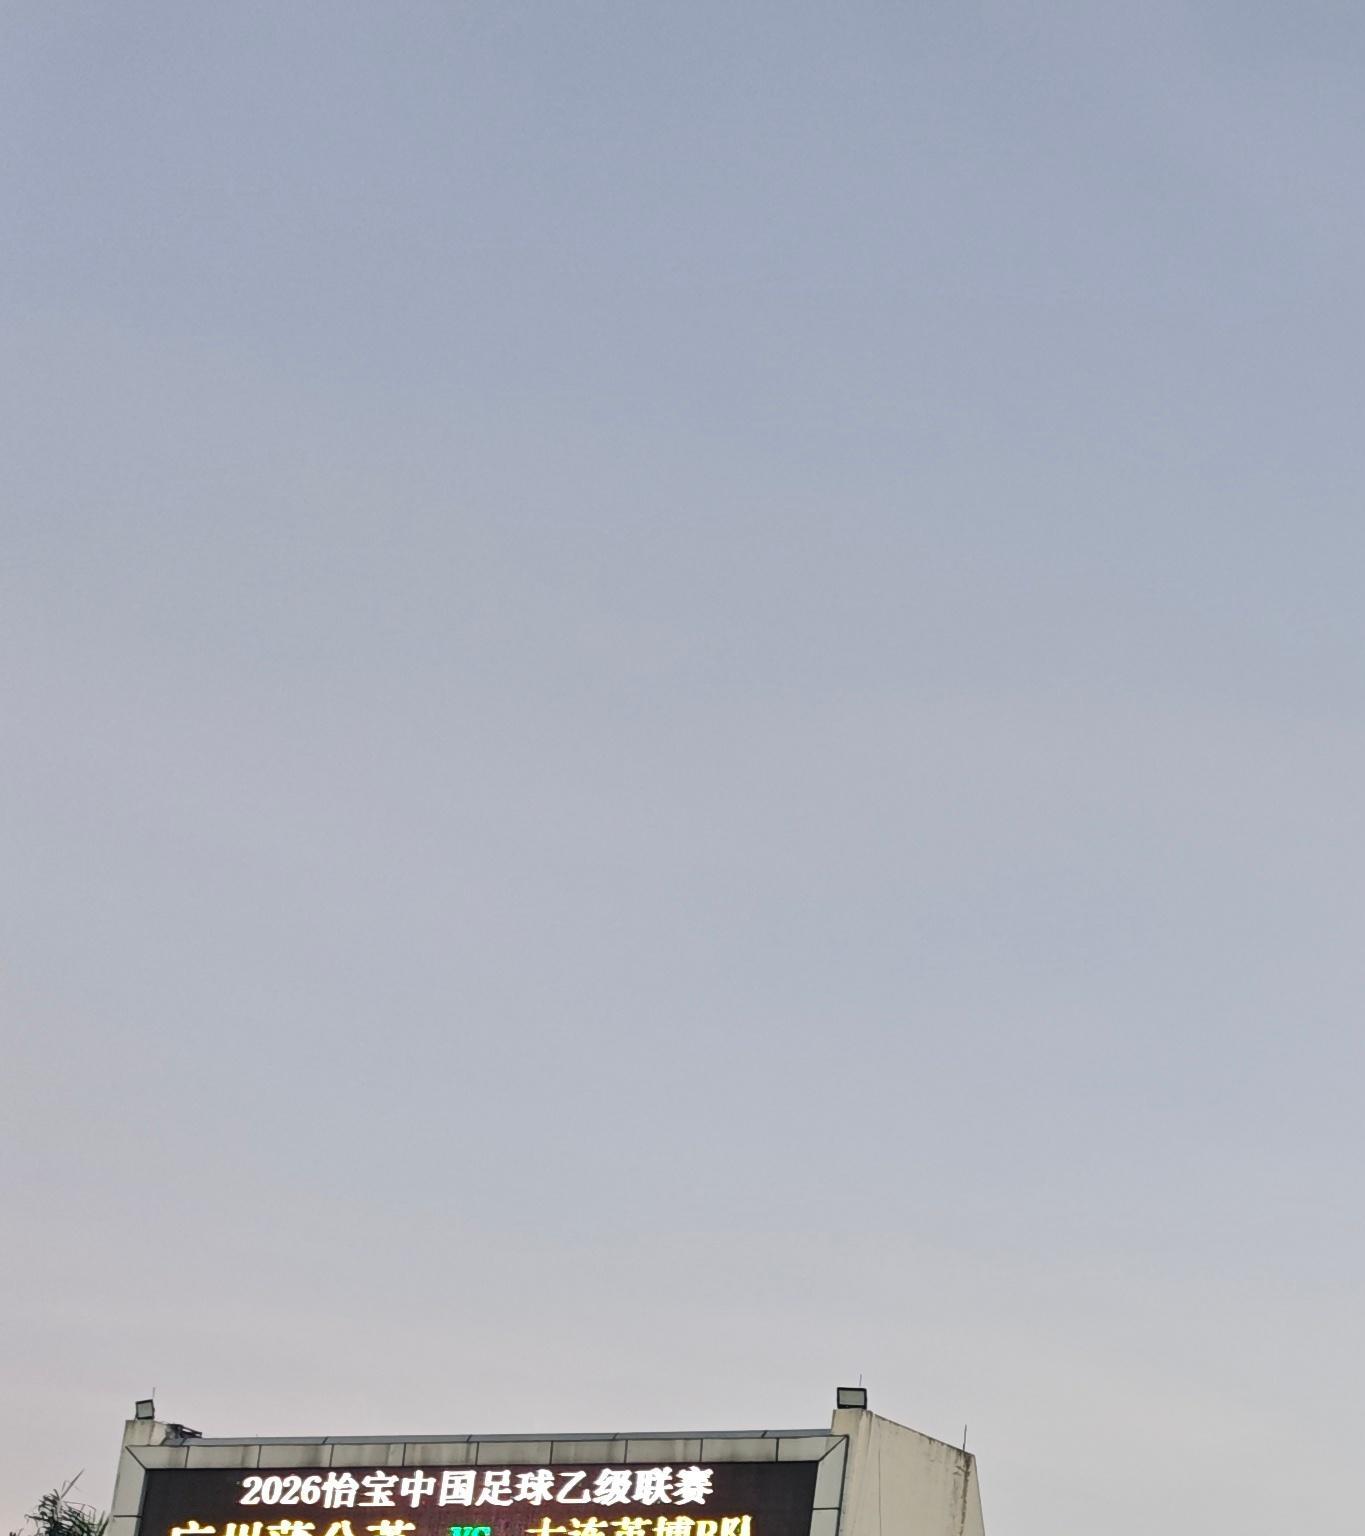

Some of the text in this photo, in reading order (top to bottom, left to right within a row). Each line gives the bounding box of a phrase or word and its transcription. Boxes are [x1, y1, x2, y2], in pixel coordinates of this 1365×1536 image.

[240, 1468, 714, 1508] 2026怡宝中国足球乙级联赛
